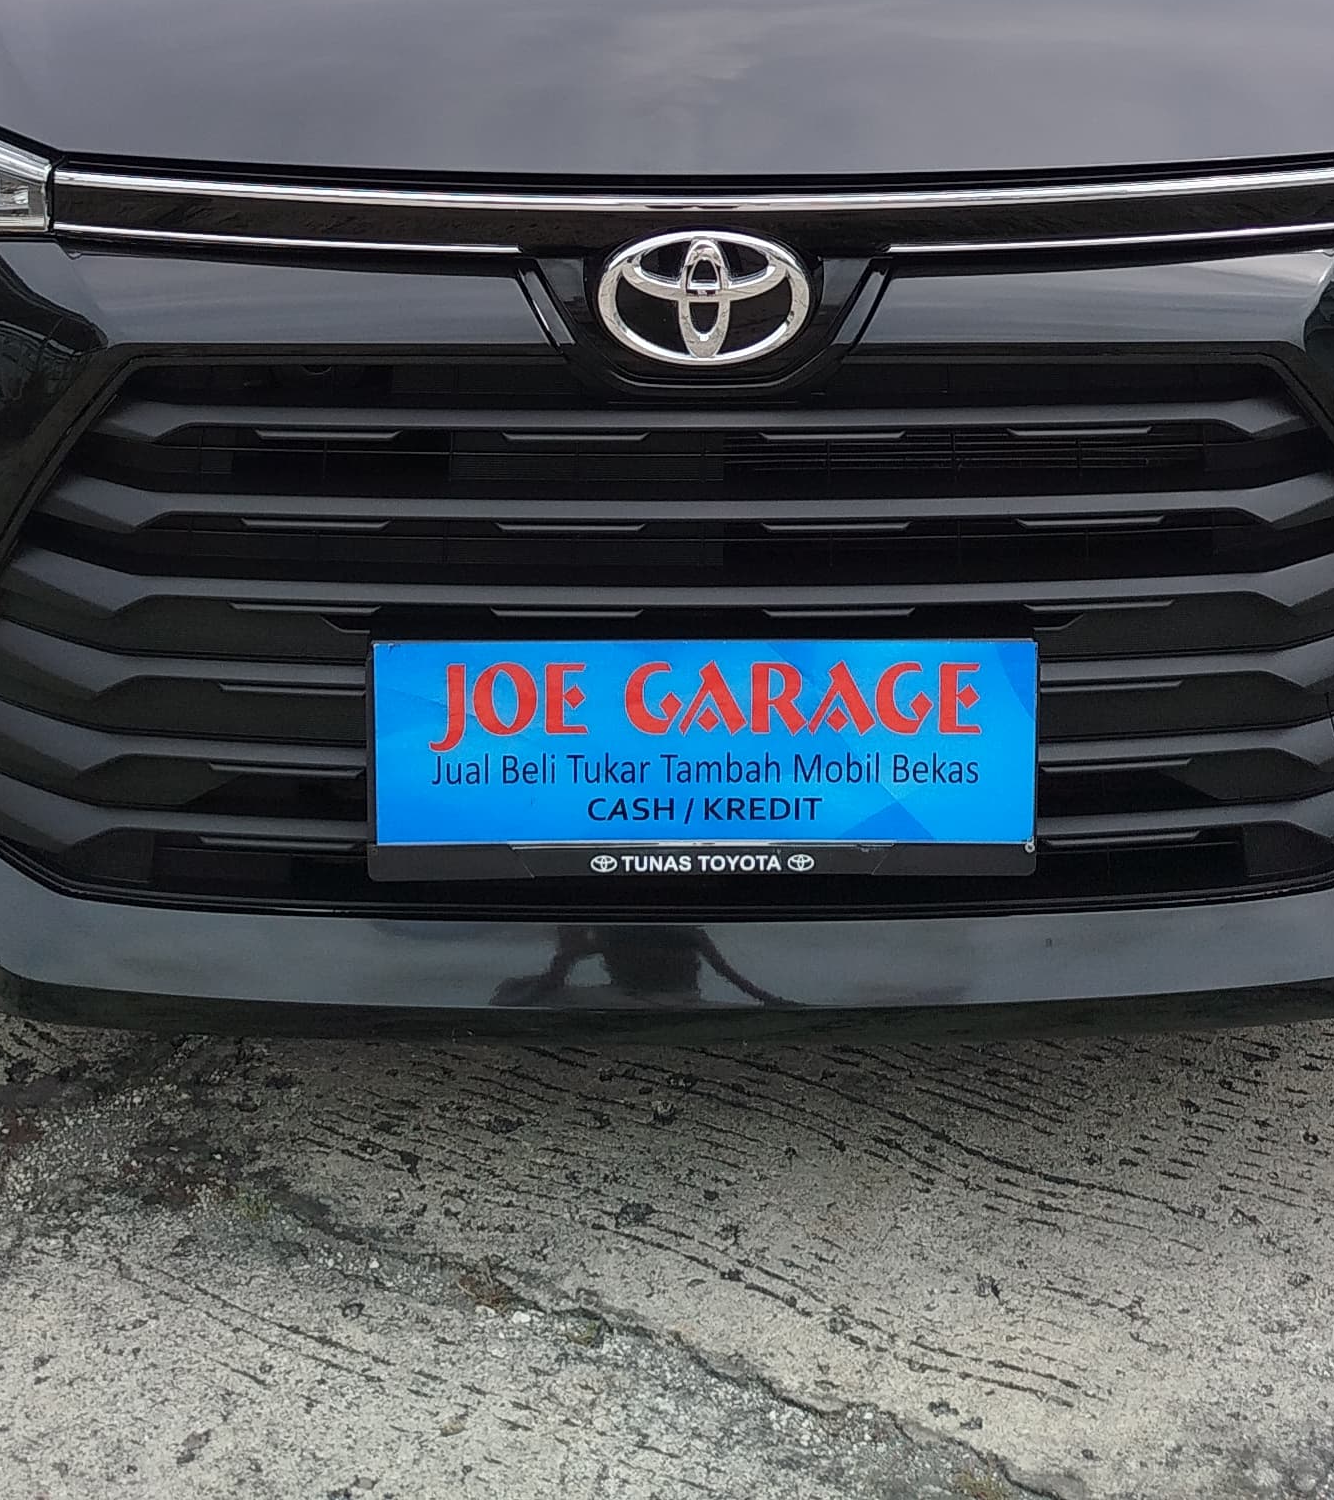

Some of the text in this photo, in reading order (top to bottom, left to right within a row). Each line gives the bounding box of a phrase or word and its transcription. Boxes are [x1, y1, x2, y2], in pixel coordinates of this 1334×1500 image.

[430, 660, 981, 752] JOE GARAGE
[432, 752, 980, 786] Jual Beli Tukar Tambah Mobil Bekas
[587, 797, 675, 822] CASH
[704, 797, 823, 822] KREDIT
[620, 854, 783, 873] TUNAS TOYOTA
